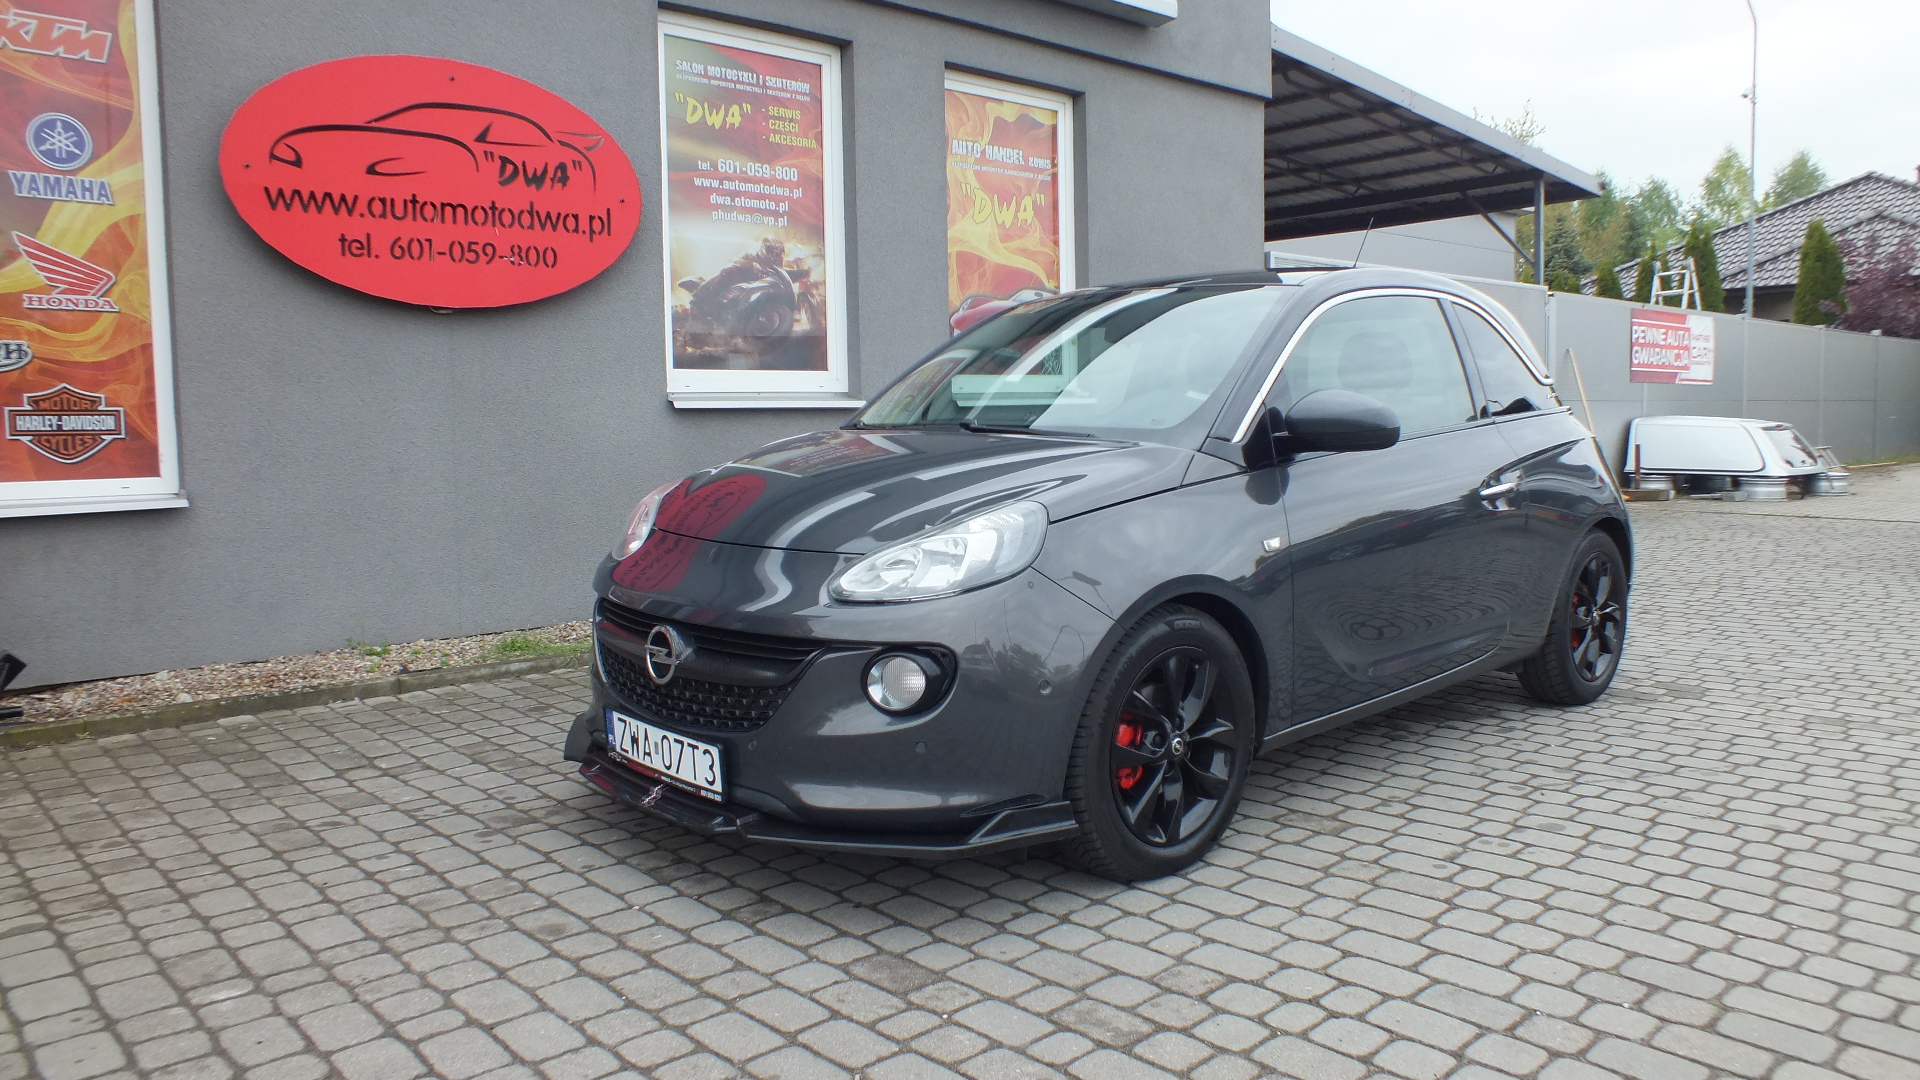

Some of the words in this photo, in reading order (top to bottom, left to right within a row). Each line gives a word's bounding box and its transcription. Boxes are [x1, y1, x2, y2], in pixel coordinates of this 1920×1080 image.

[676, 59, 704, 75] SALON
[707, 65, 757, 84] MOTOCYKLI
[759, 74, 763, 85] I
[766, 75, 810, 93] SKUTERÓW
[674, 92, 751, 130] "DWA"
[768, 106, 801, 120] SERWIS
[769, 119, 799, 133] CZĘŚCI
[769, 133, 817, 149] AKCESORIA
[952, 139, 981, 159] AUTO
[985, 144, 1025, 166] HANDEL
[1028, 156, 1052, 170] KOMIS
[484, 149, 583, 190] "DWA"
[698, 160, 714, 171] tel.
[717, 158, 798, 182] 601-059-800
[9, 171, 113, 204] YAMAHA
[694, 176, 803, 198] www.automotodwa.pl
[263, 185, 612, 242] www.automotodwa.pl
[710, 193, 789, 212] dwa.otomoto.pl
[960, 182, 1045, 229] "DWA"
[712, 210, 788, 228] phudwa@vp.pl
[339, 232, 379, 259] tel.
[390, 236, 558, 269] 601-059-800
[23, 295, 119, 311] HONDA
[1632, 326, 1666, 345] PEWNE
[1666, 330, 1690, 347] AUTA
[1632, 346, 1690, 367] GWARANCJA
[16, 415, 116, 431] HARLEY-DAVIDSON
[617, 716, 654, 765] ZWA
[660, 734, 717, 787] 07T3
